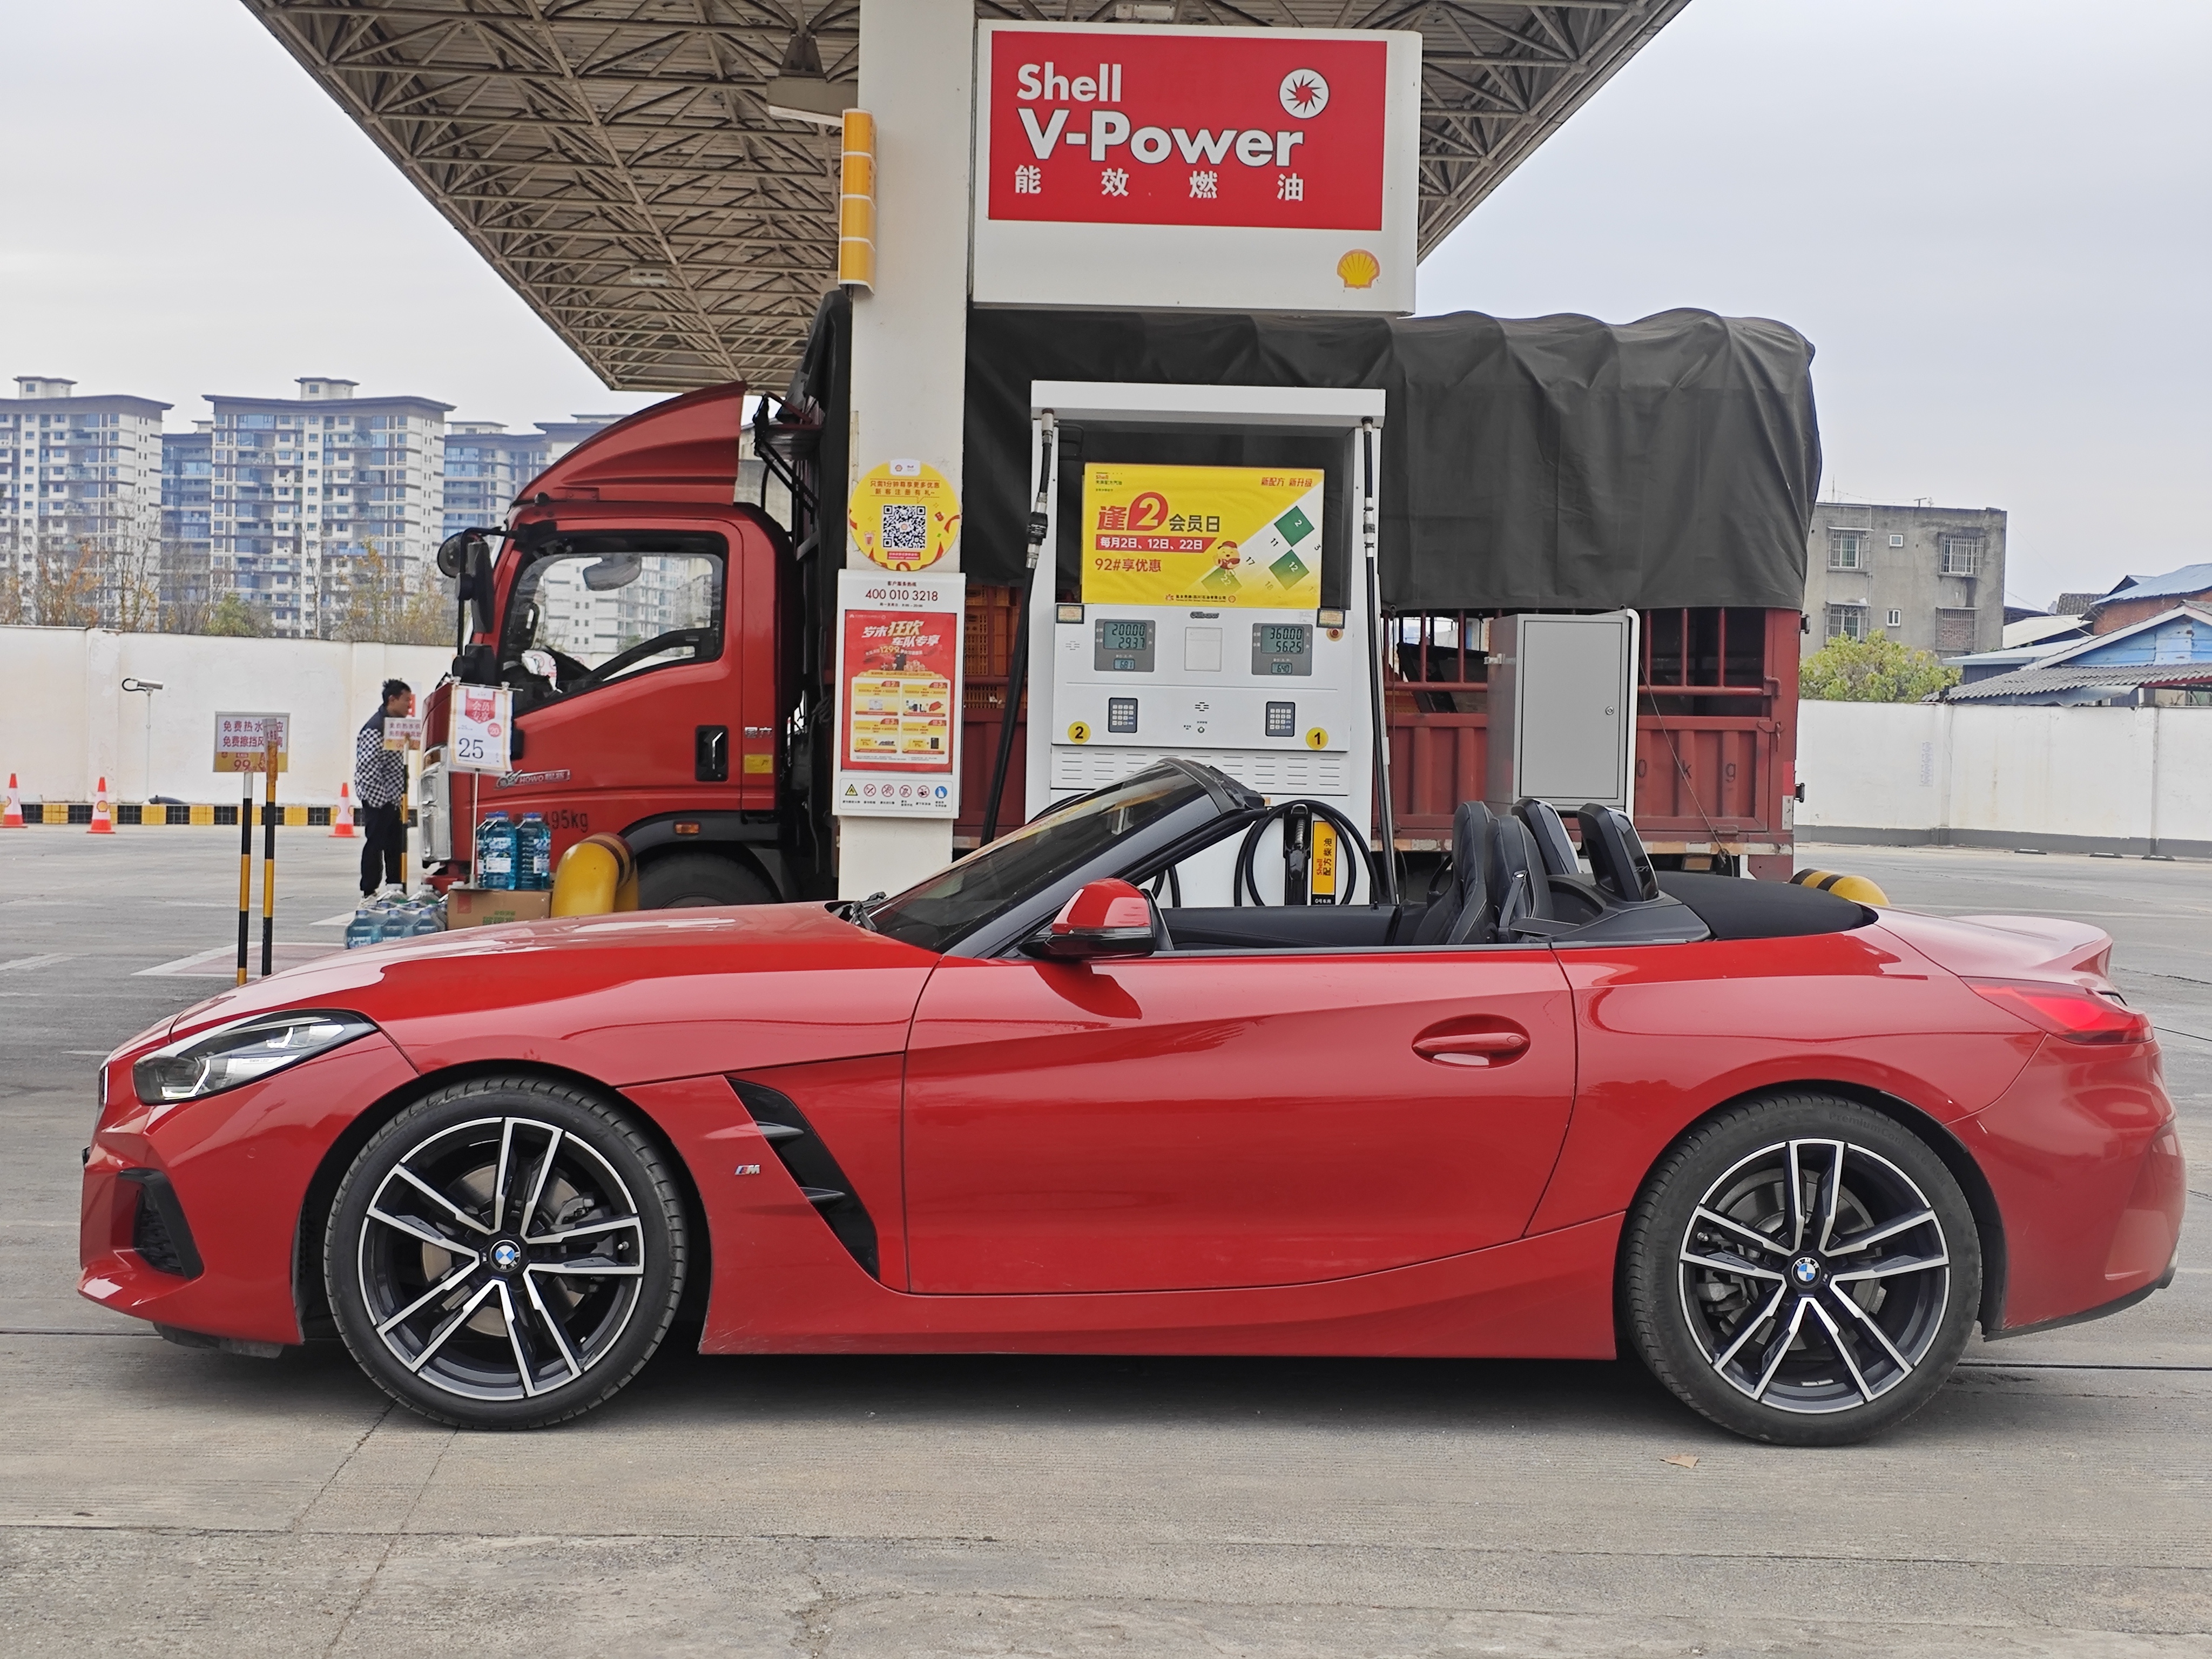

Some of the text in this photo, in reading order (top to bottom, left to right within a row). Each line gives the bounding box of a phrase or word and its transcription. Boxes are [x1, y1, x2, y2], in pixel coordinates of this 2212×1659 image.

[1016, 62, 1122, 102] Shell
[1016, 107, 1304, 167] V-Power
[1015, 165, 1304, 201] 能效燃油
[1261, 477, 1313, 487] 新配方 新升级
[1294, 519, 1303, 527] 2
[1100, 536, 1203, 550] 每月2日、12日、22日
[1270, 537, 1279, 547] 11
[1095, 558, 1162, 572] 92#享优惠
[1245, 556, 1256, 566] 17
[1289, 561, 1299, 572] 12
[1264, 581, 1274, 591] 18
[865, 589, 939, 601] 400 010 3218
[861, 620, 925, 638] 岁末狂欢
[1111, 624, 1145, 636] 200.00
[1270, 628, 1303, 640] 360.00
[891, 635, 941, 648] 车队专享
[1118, 637, 1145, 649] 29.37
[1276, 640, 1302, 653] 56.25
[223, 720, 284, 732] 免费热水应
[1074, 726, 1084, 739] 2
[1313, 732, 1321, 745] 1
[222, 735, 283, 748] 免费擦挡风璃
[458, 737, 484, 759] 25
[234, 759, 252, 771] 99
[520, 774, 544, 784] HOWO
[1323, 838, 1332, 876] 配方柴油
[1796, 1257, 1819, 1269] BMW
